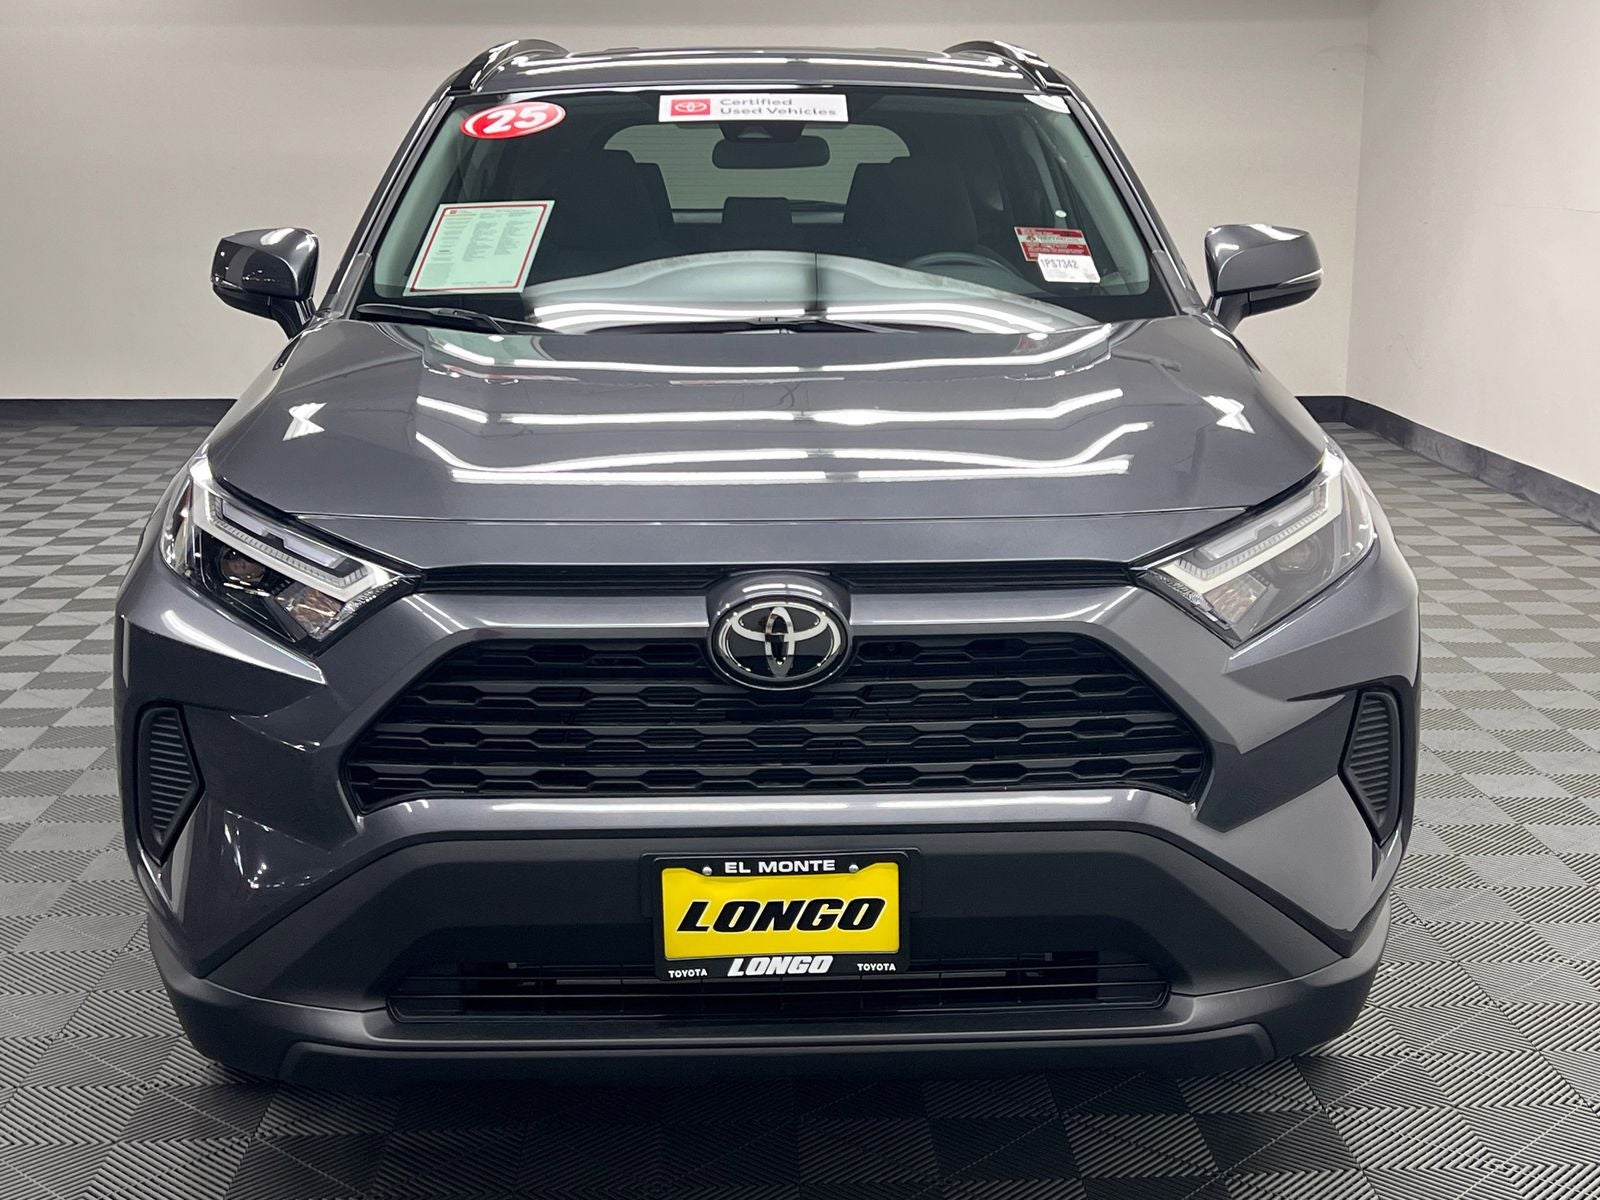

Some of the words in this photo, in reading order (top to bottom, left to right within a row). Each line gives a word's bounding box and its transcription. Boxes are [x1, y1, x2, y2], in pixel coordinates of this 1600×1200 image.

[720, 98, 792, 106] Certified
[720, 107, 762, 115] Used
[766, 107, 837, 115] Vehicles
[482, 103, 550, 134] 25
[1040, 258, 1079, 269] 1PS7342
[724, 861, 751, 874] EL
[758, 859, 836, 873] MONTE
[676, 897, 886, 933] LONGO
[727, 955, 833, 977] LONGO
[857, 963, 896, 972] TOYOTA
[668, 968, 708, 978] TOYOTA
